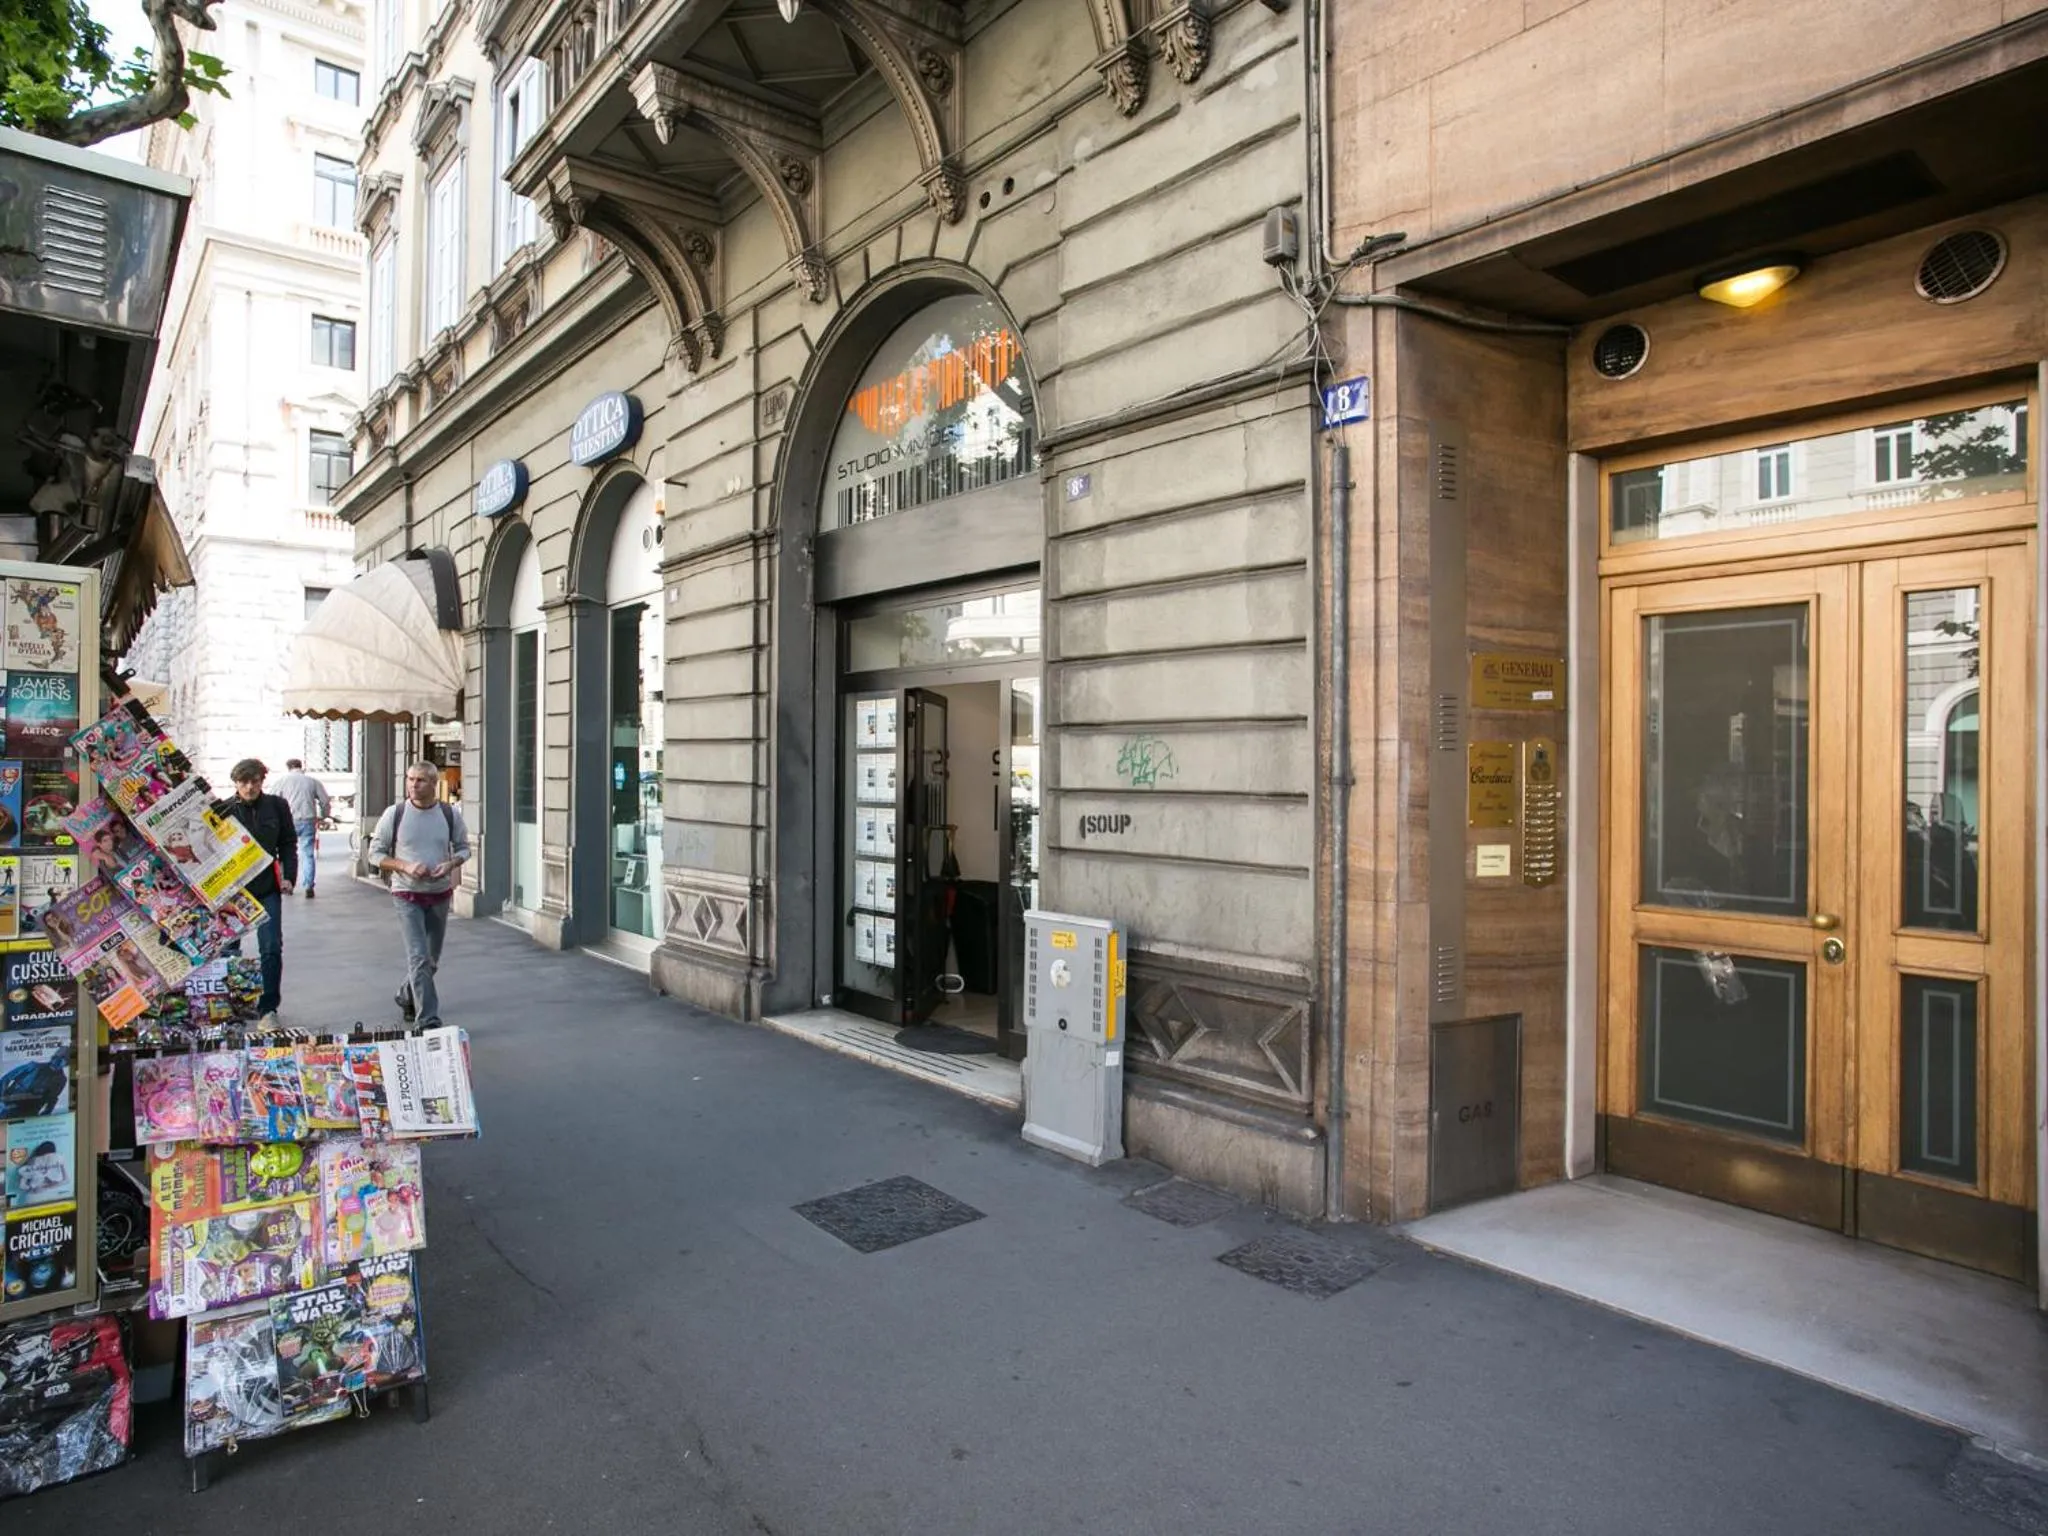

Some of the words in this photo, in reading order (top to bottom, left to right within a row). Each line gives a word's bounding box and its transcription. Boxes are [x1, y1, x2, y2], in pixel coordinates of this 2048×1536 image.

[1337, 385, 1350, 412] 8
[572, 396, 624, 443] OTTICA
[572, 419, 626, 461] TRIESTINA
[837, 447, 891, 480] STUDIO
[17, 677, 66, 690] JAMES
[11, 687, 72, 702] ROLLINS
[21, 726, 61, 737] ARTICO
[1470, 765, 1513, 784] Carducci
[1086, 814, 1132, 834] SOUP
[29, 950, 59, 964] CLIVE
[11, 1009, 74, 1021] URAGANO
[396, 1053, 411, 1100] PICCOLO
[1458, 1101, 1492, 1123] GAS
[21, 1216, 63, 1233] MICHAEL
[9, 1226, 73, 1251] CRICHTON
[19, 1244, 63, 1260] NEXT
[360, 1258, 409, 1278] WARS
[290, 1288, 346, 1311] STAR
[291, 1300, 347, 1324] WARS
